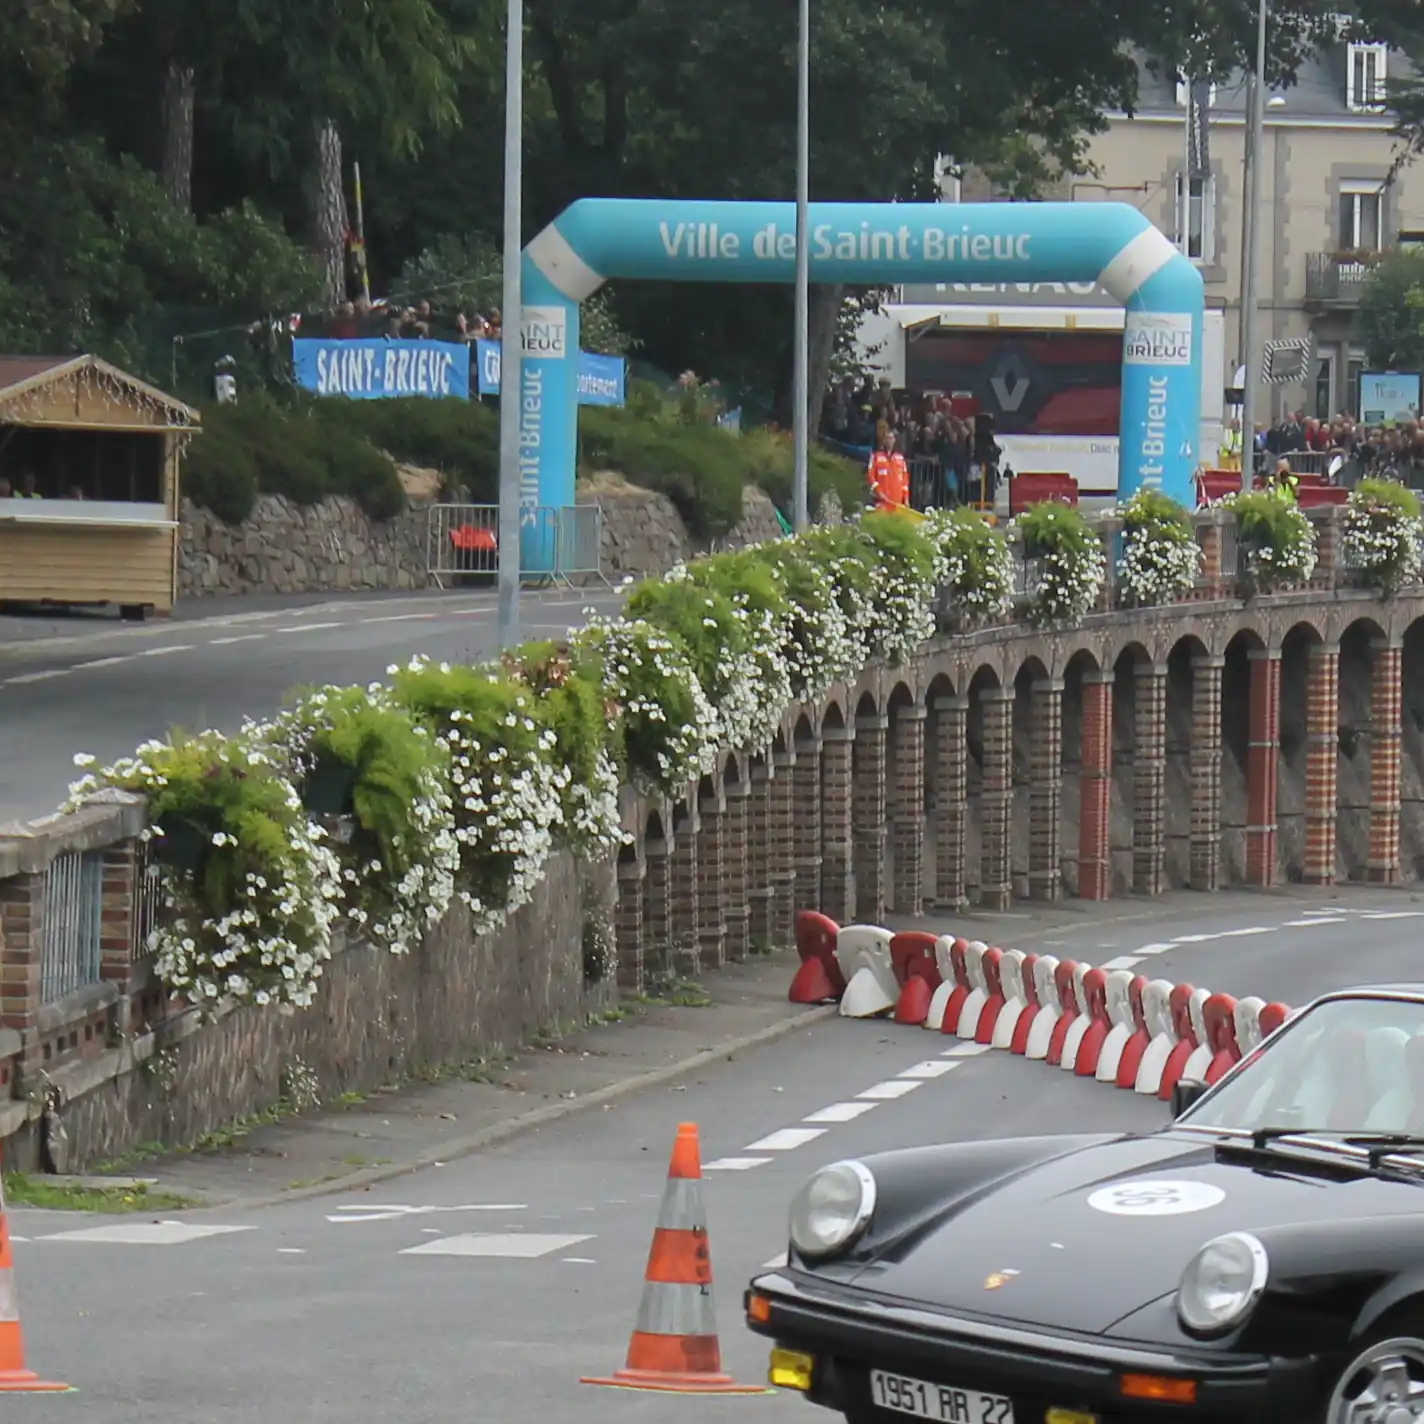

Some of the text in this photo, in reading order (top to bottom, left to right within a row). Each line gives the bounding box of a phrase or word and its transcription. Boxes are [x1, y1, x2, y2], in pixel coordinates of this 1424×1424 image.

[659, 221, 740, 259] Ville
[753, 222, 797, 260] de
[1126, 329, 1190, 346] SAINT
[1126, 342, 1188, 359] BRIEUC
[316, 348, 454, 394] SAINT-BRIEUC
[876, 1373, 929, 1416] 1951
